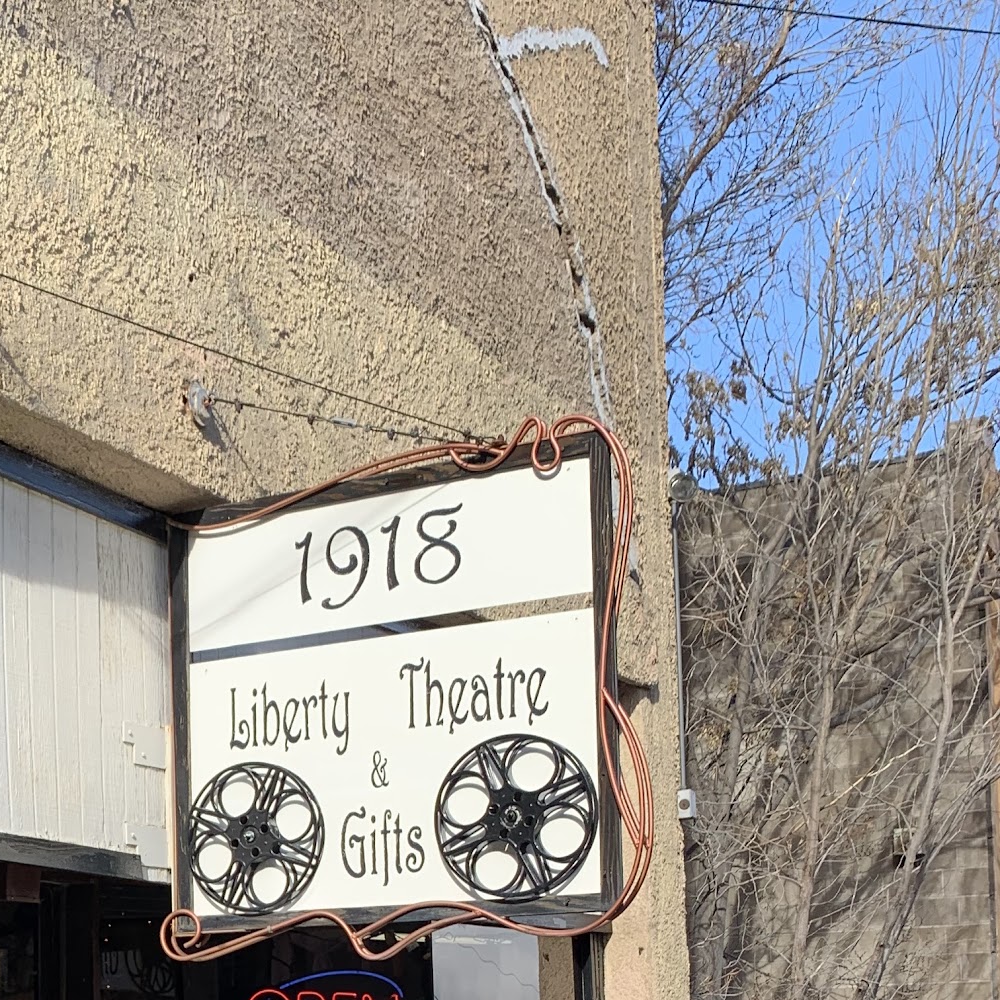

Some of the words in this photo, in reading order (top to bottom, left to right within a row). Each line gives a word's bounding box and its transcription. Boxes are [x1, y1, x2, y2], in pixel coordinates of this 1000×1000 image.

[295, 502, 464, 610] 1918
[229, 679, 351, 756] Liberty
[399, 657, 550, 735] Theatre
[370, 750, 390, 789] &
[341, 806, 427, 887] Gifts
